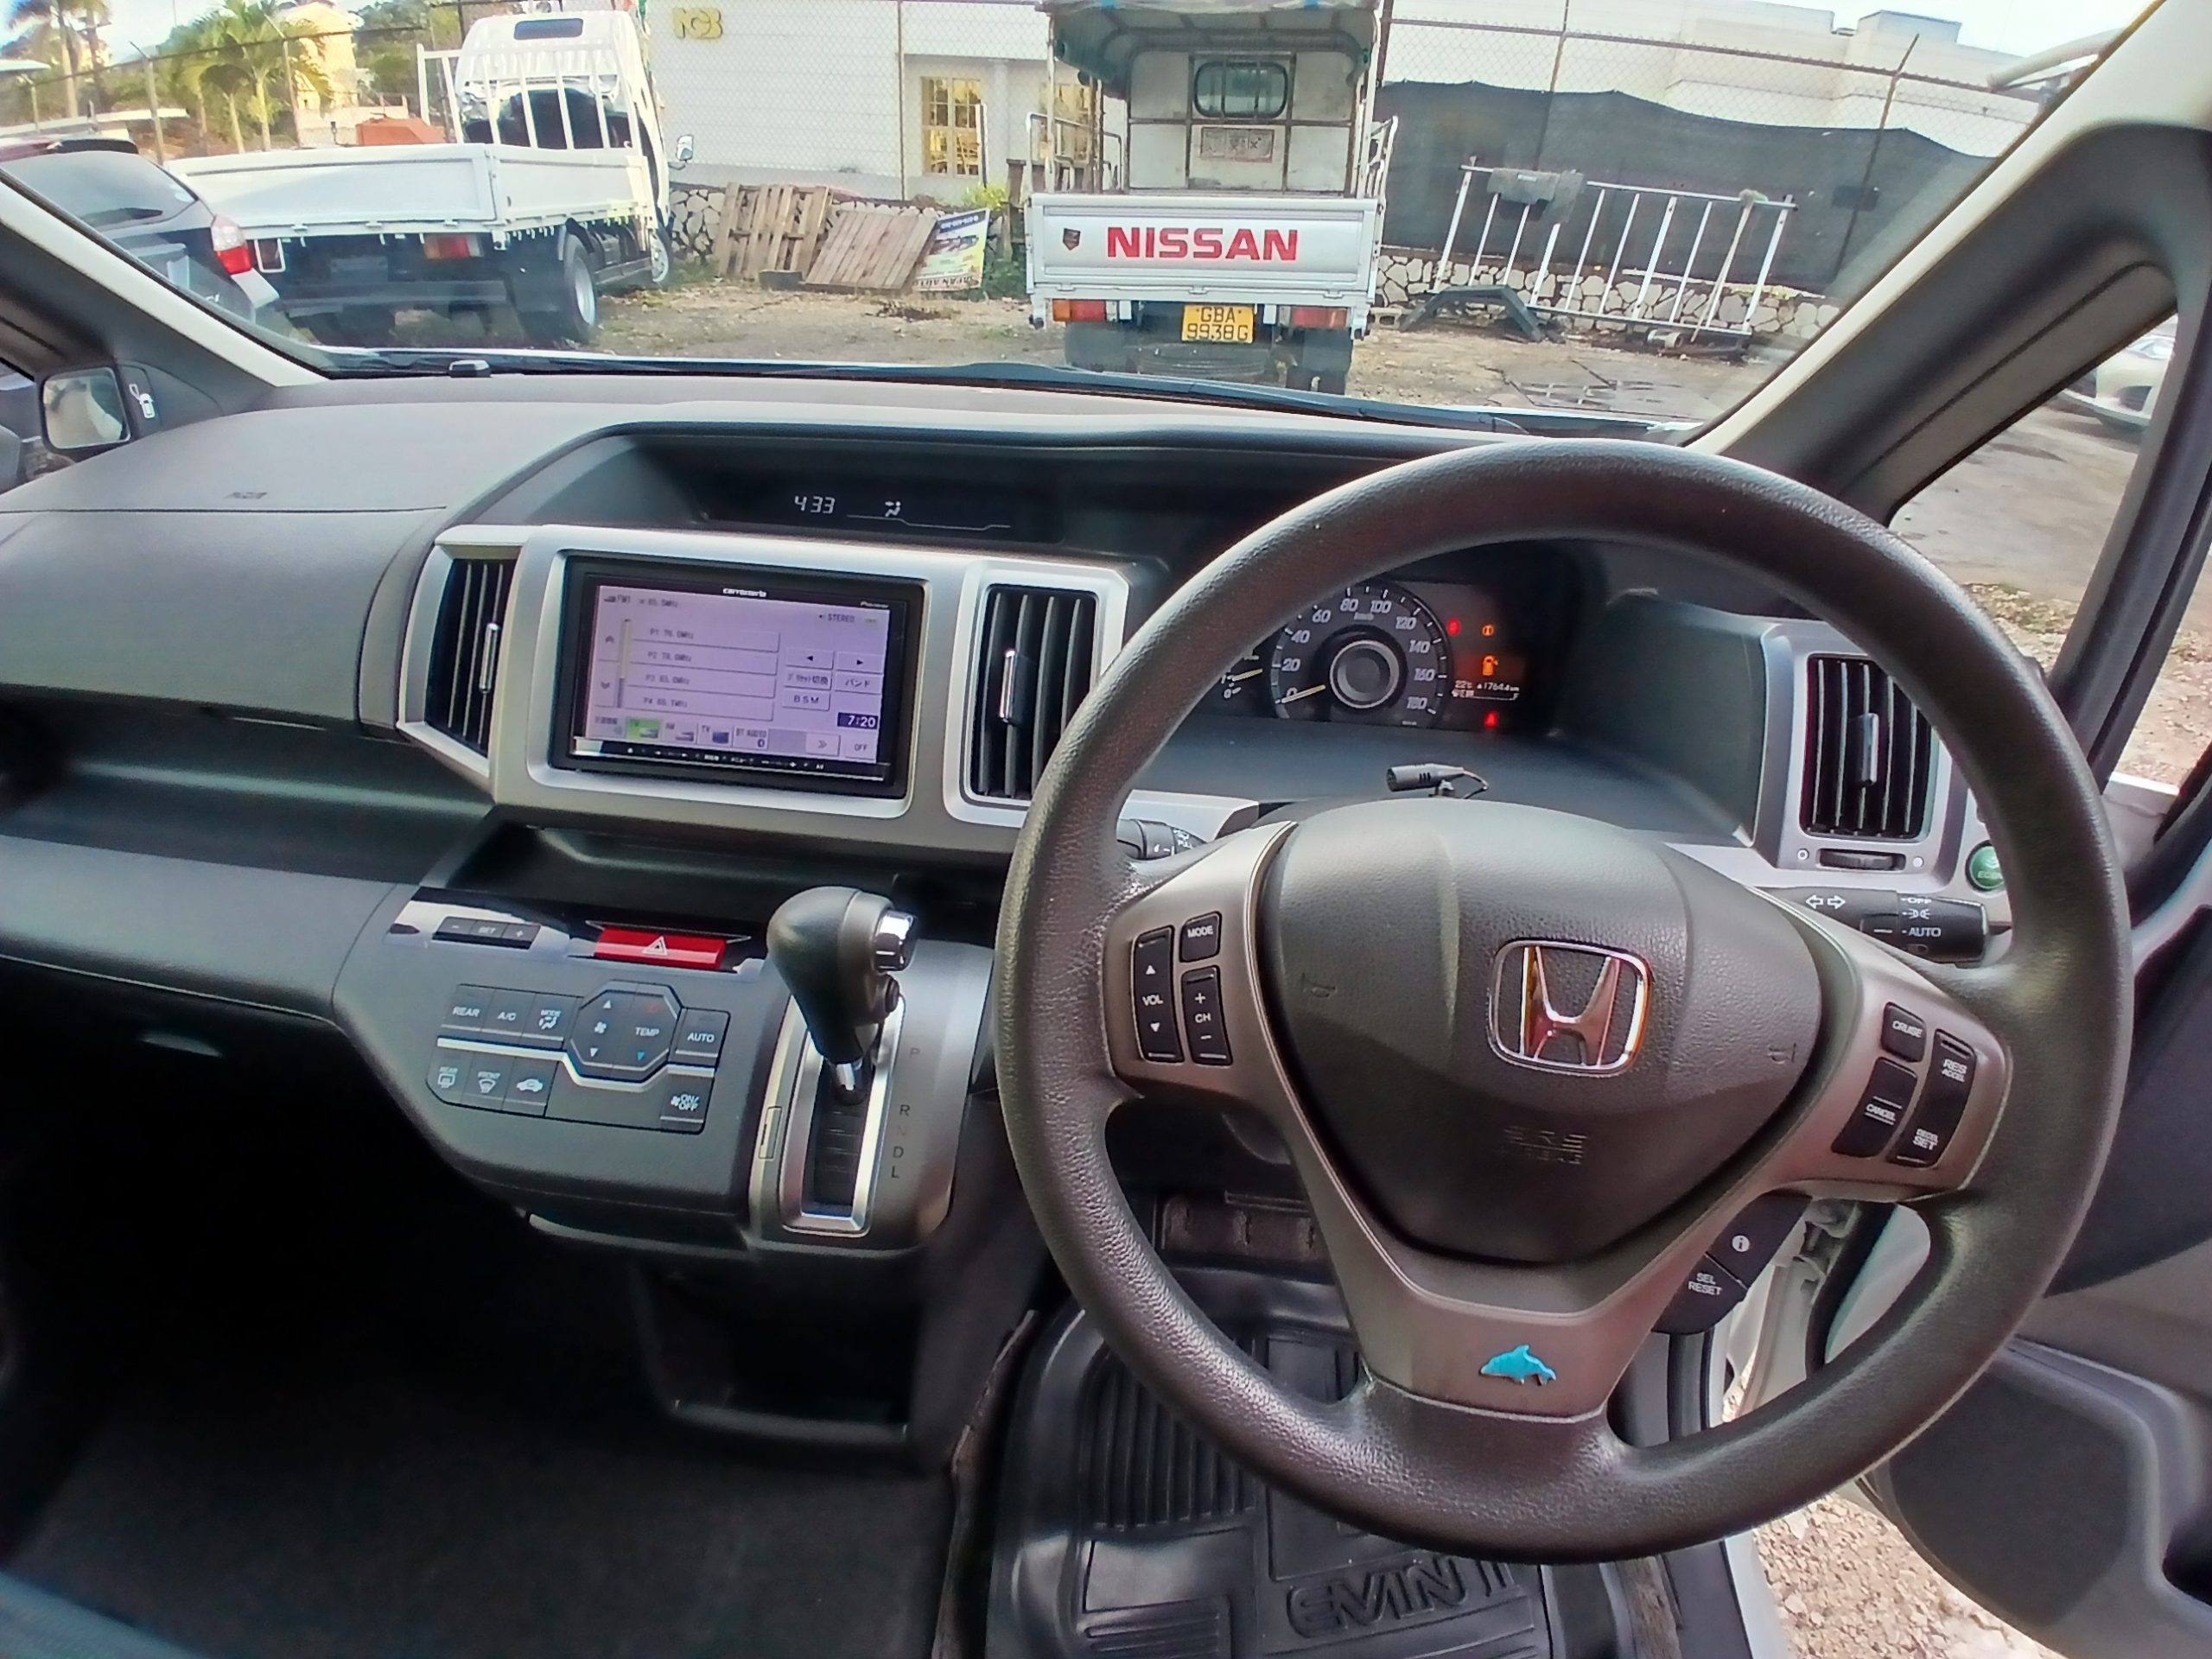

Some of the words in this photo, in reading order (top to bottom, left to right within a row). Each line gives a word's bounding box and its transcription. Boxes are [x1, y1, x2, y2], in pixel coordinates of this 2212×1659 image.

[1108, 226, 1298, 261] NISSAN
[1201, 307, 1236, 323] GBA
[1340, 598, 1359, 612] 80
[1370, 600, 1391, 613] 100
[828, 613, 855, 623] STEREO
[1312, 609, 1332, 623] 60
[1395, 616, 1417, 629] 120
[1291, 630, 1311, 644] 40
[1408, 639, 1430, 653] 140
[1281, 658, 1301, 671] 20
[1414, 667, 1435, 681] 160
[1406, 696, 1427, 709] 180
[848, 715, 877, 728] 7:20
[1907, 897, 1932, 906] OFF
[1187, 925, 1214, 938] MODE
[1908, 927, 1942, 938] AUTO
[1142, 995, 1164, 1006] VOL
[452, 1006, 480, 1018] REAR
[1195, 1013, 1211, 1023] CH
[635, 1026, 660, 1037] TEMP
[1892, 1020, 1923, 1037] CRUISE
[687, 1032, 715, 1044] AUTO
[910, 1047, 920, 1056] P
[899, 1104, 911, 1116] R
[1866, 1103, 1896, 1122] CANCEL
[1912, 1135, 1937, 1151] SET
[893, 1146, 904, 1159] D
[891, 1166, 899, 1179] L
[1696, 1272, 1717, 1285] SEL
[1688, 1281, 1723, 1295] RESET
